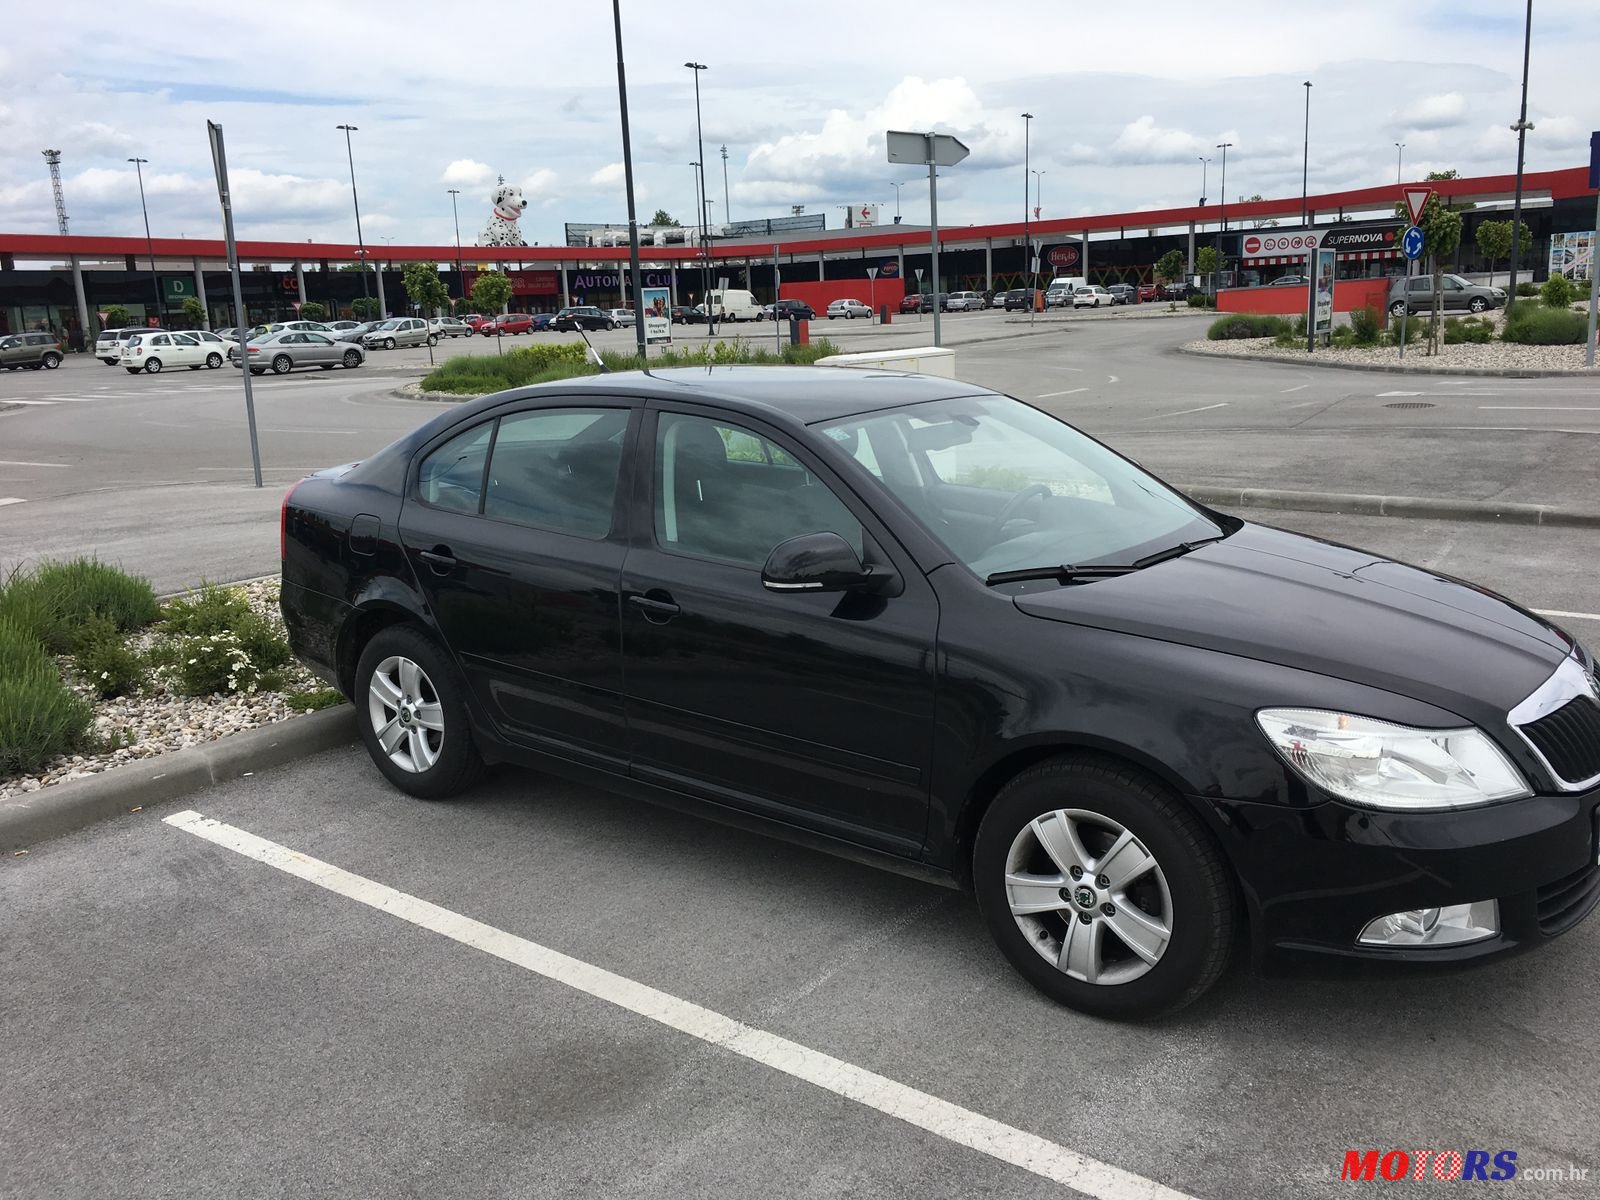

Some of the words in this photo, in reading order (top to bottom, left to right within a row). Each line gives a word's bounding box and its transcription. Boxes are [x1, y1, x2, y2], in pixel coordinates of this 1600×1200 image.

[1328, 233, 1383, 245] SUPERNOVA
[1051, 251, 1076, 262] Hervis
[574, 274, 635, 289] AUTOMA
[646, 273, 680, 287] CLU
